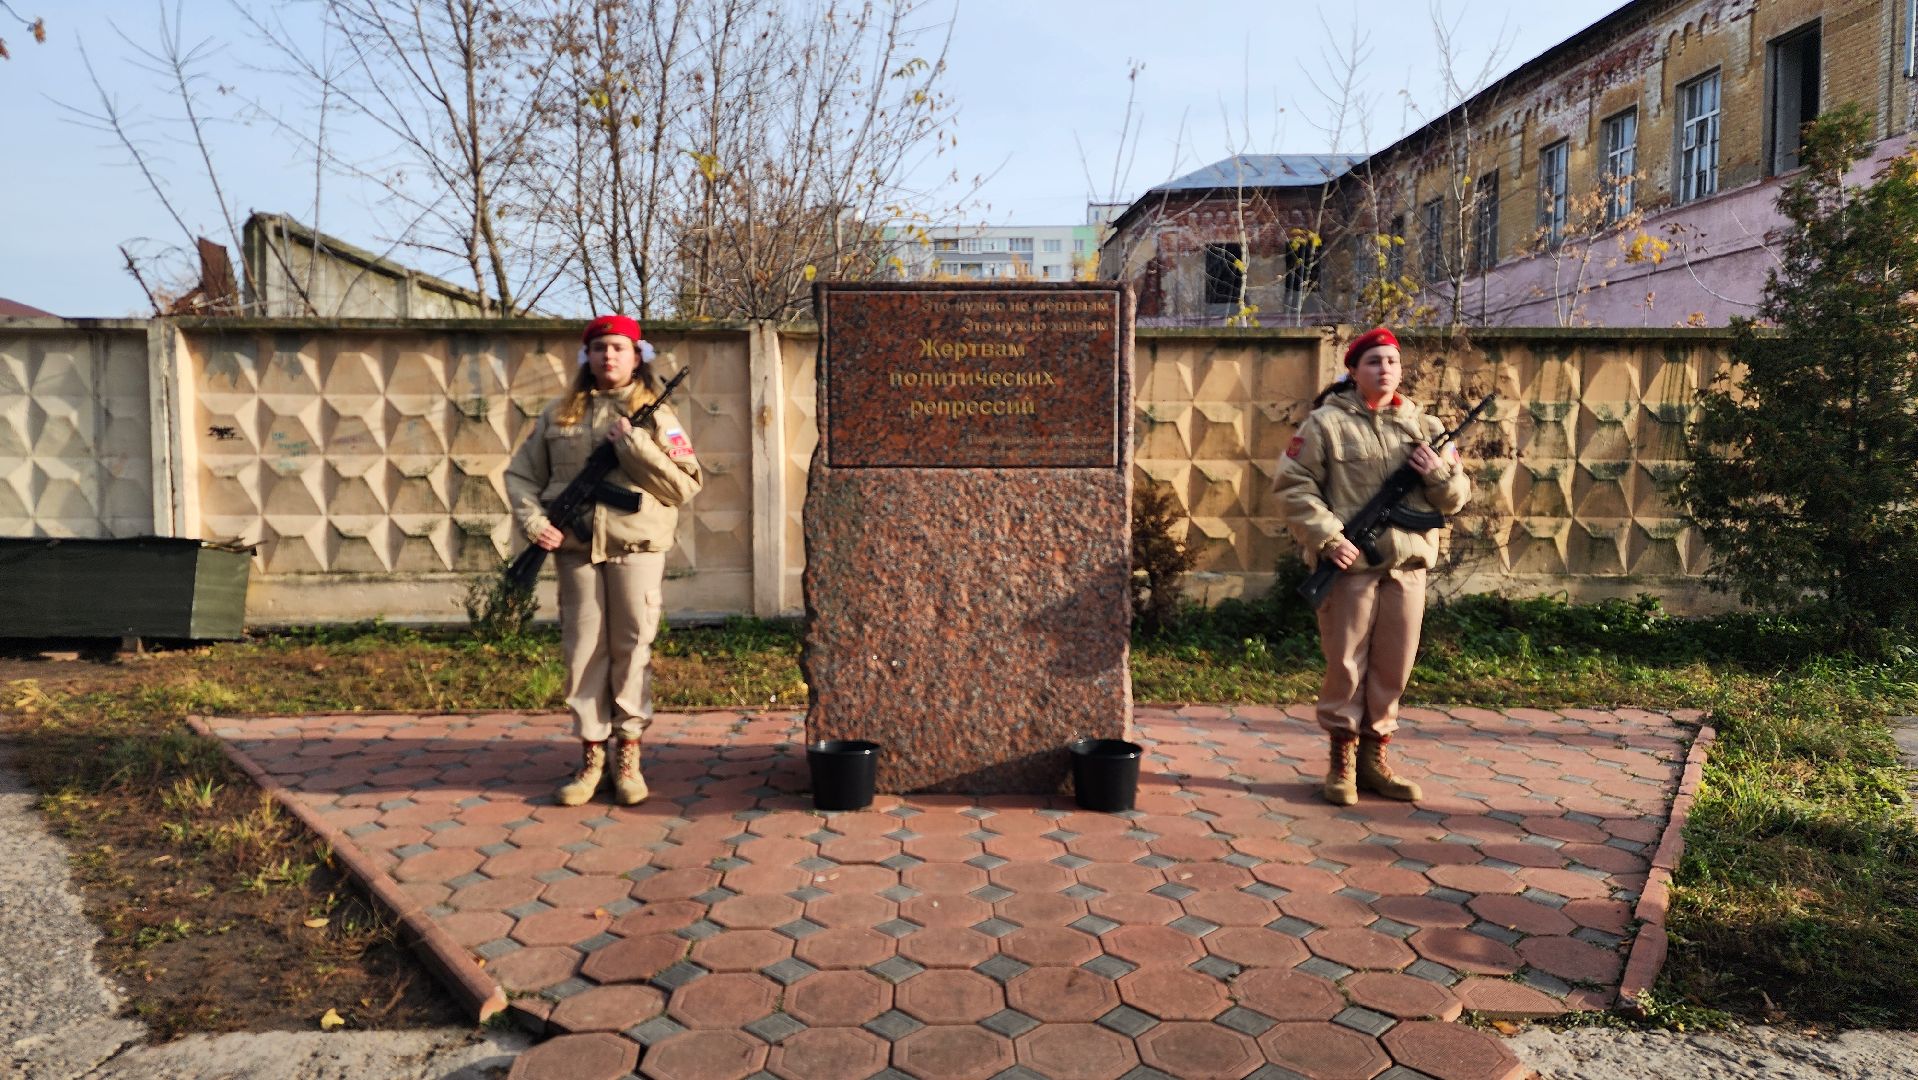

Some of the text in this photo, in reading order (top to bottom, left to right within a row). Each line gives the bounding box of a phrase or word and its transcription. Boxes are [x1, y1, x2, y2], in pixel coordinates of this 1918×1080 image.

[962, 318, 992, 333] Это
[995, 320, 1047, 336] нужно
[918, 337, 1026, 363] Жертвам
[889, 370, 1056, 388] политических
[910, 394, 1037, 420] репрессий
